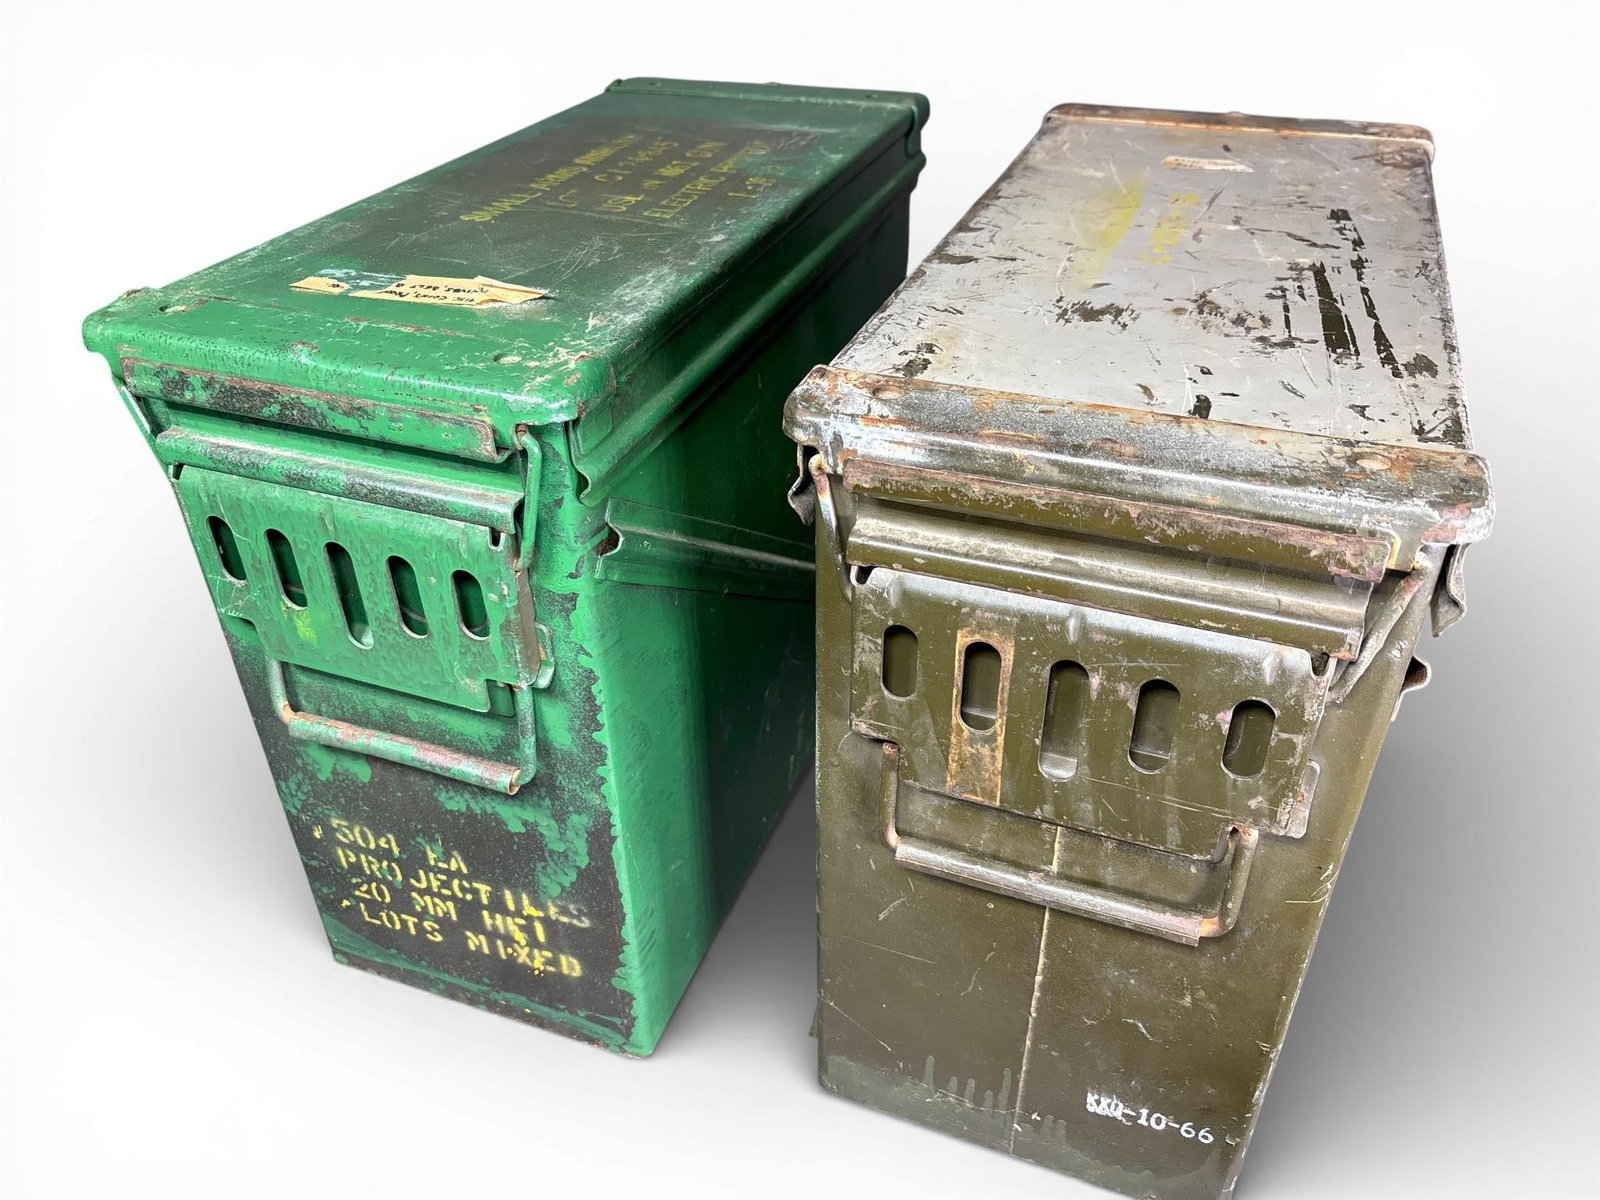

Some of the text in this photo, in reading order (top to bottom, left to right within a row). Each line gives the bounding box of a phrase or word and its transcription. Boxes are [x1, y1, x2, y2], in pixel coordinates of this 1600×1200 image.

[459, 191, 543, 223] SMALL
[643, 173, 726, 219] ELECTRIC
[351, 877, 391, 903] 20
[411, 891, 458, 921] MM
[359, 902, 583, 978] LOTS MIXED
